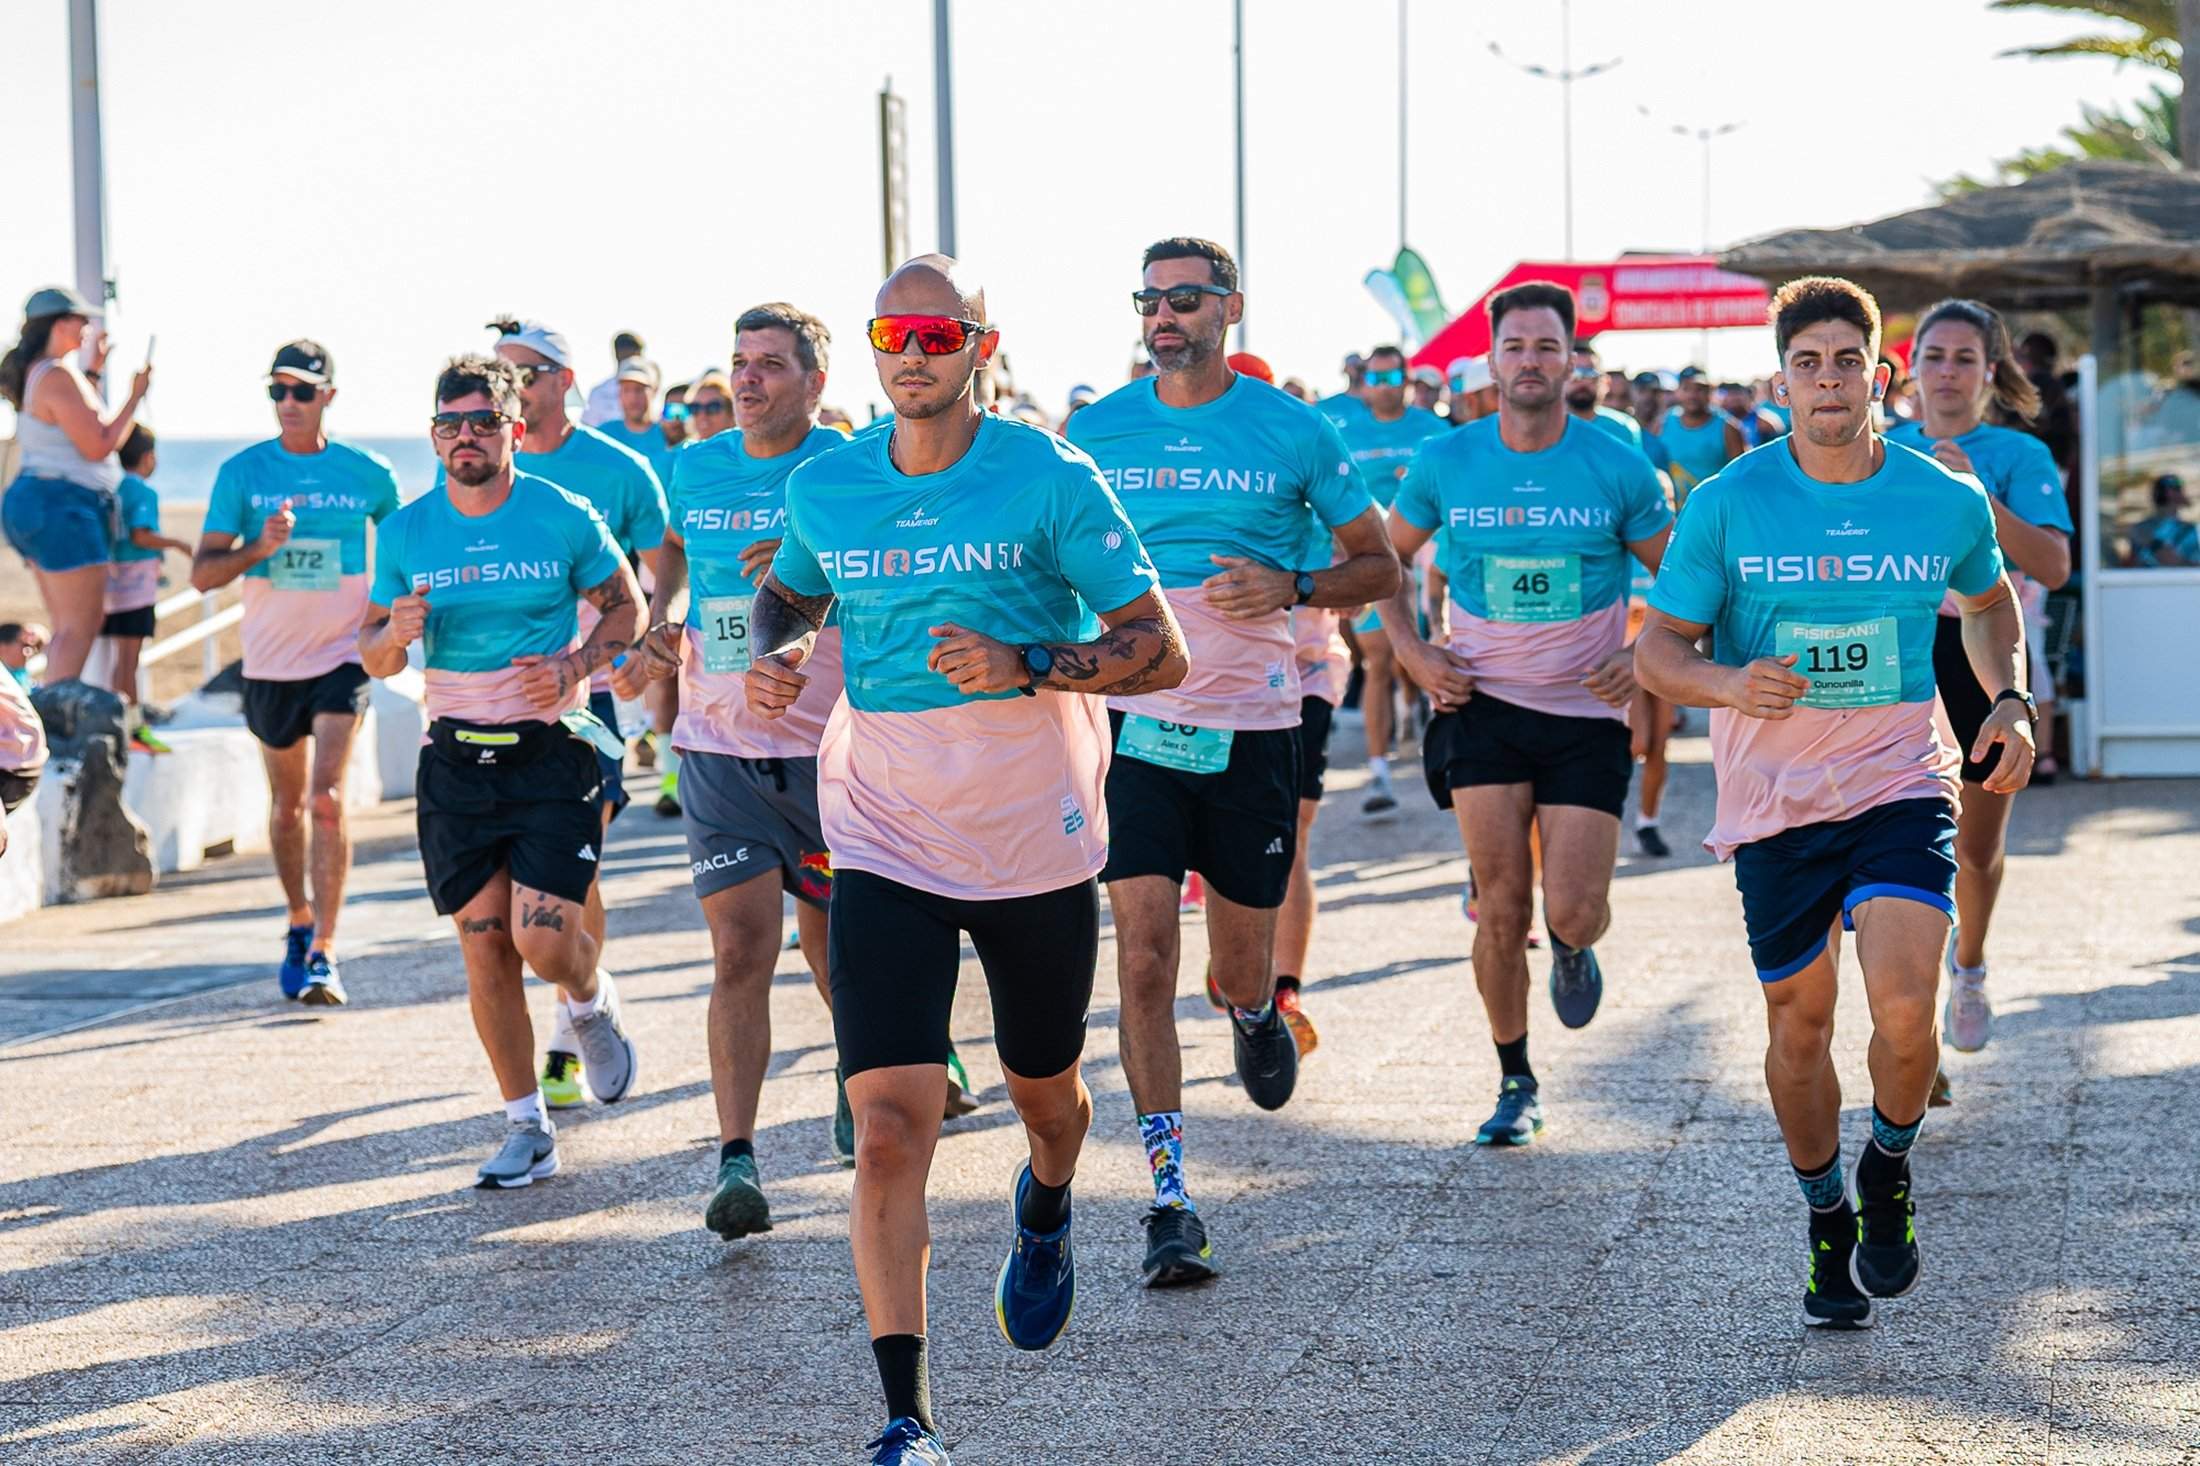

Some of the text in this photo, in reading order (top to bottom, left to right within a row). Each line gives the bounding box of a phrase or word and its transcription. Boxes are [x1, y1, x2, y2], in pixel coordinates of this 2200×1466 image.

[1255, 471, 1276, 495] 5K
[682, 508, 787, 531] FISIOSA
[1449, 506, 1590, 528] FISIOSAN
[284, 551, 324, 569] 172
[817, 542, 1024, 579] FISIOSAN 5K
[1738, 555, 1929, 583] FISIOSAN
[411, 562, 541, 589] FISIOSAN
[1512, 573, 1550, 595] 46
[716, 615, 750, 641] 15
[1793, 626, 1869, 640] FISIOSAN
[1807, 643, 1868, 673] 119
[692, 847, 749, 876] RACLE
